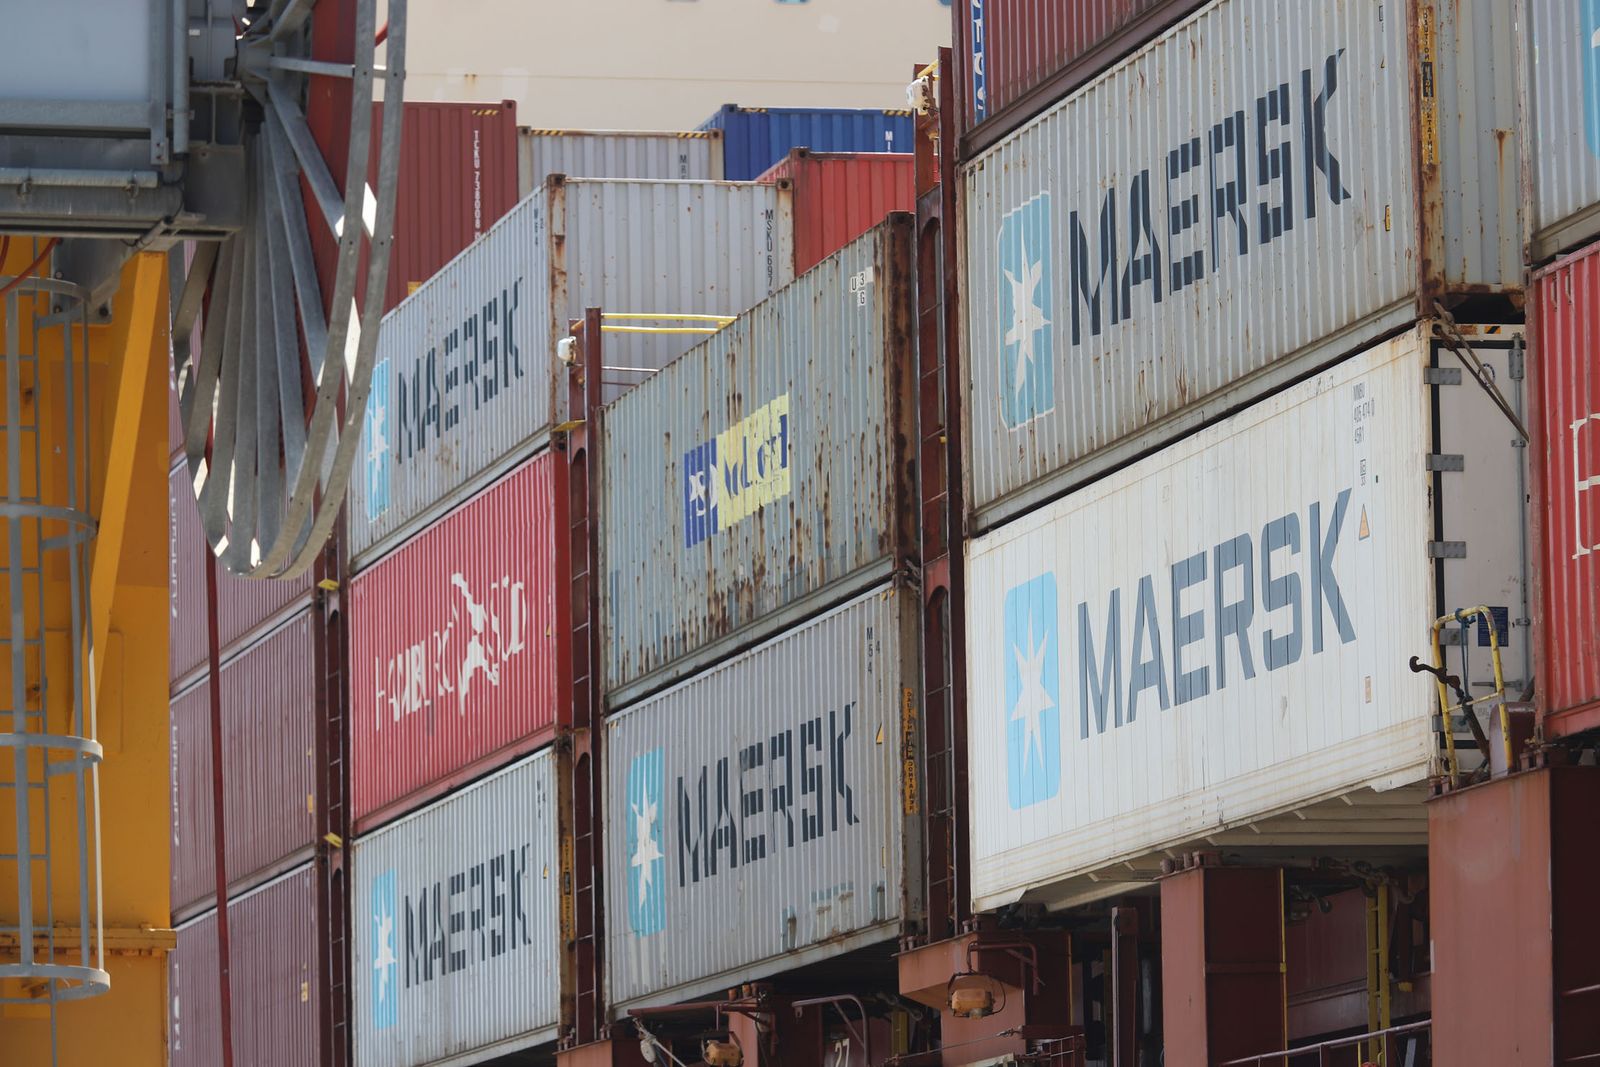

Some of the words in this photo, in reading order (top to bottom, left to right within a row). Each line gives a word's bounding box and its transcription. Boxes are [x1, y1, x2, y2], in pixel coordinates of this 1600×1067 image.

[766, 209, 774, 252] MSKU
[1070, 48, 1352, 345] MAERSK
[398, 276, 524, 464] MAERSK
[1077, 487, 1356, 740] MAERSK
[677, 701, 860, 887] MAERSK
[405, 843, 531, 988] MAERSK
